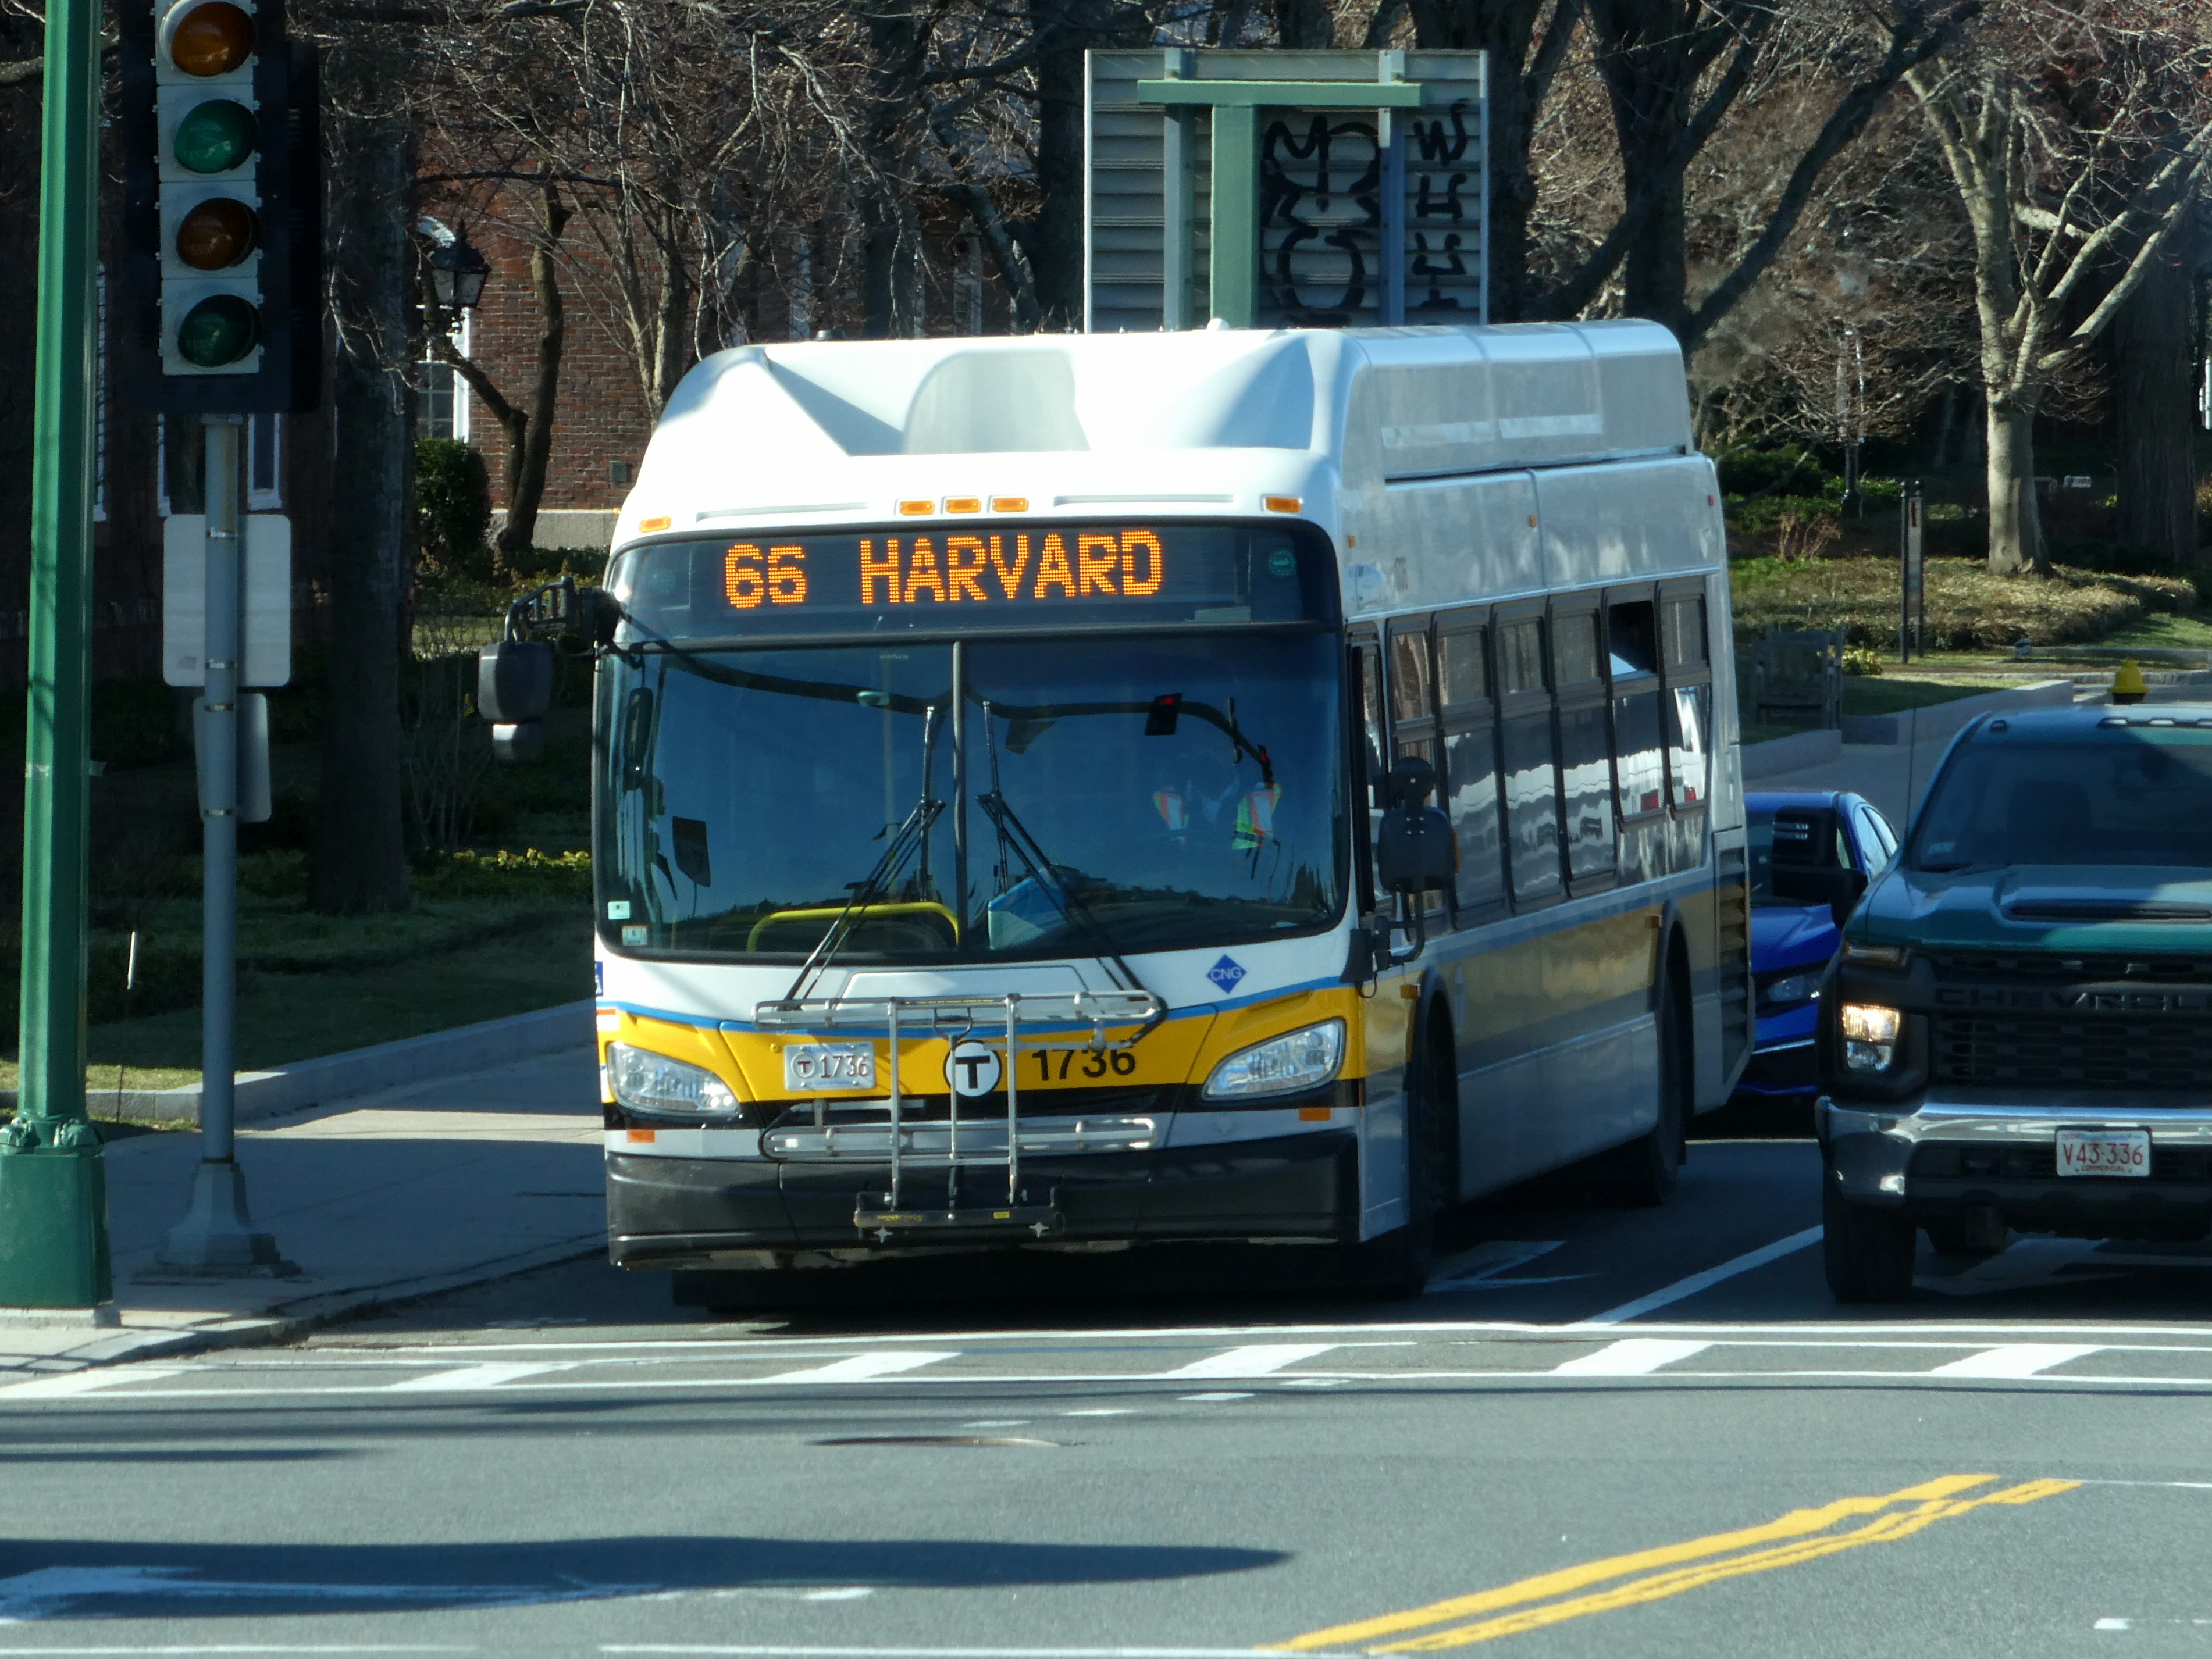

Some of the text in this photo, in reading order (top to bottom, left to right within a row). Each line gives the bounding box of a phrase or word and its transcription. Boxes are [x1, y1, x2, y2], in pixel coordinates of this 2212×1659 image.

[724, 529, 1162, 608] 66 HARVARD
[1210, 966, 1242, 981] CNG
[1935, 988, 2212, 1011] CHEVROL
[819, 1054, 870, 1078] 1736
[955, 1055, 991, 1089] T
[1031, 1048, 1136, 1082] 1736
